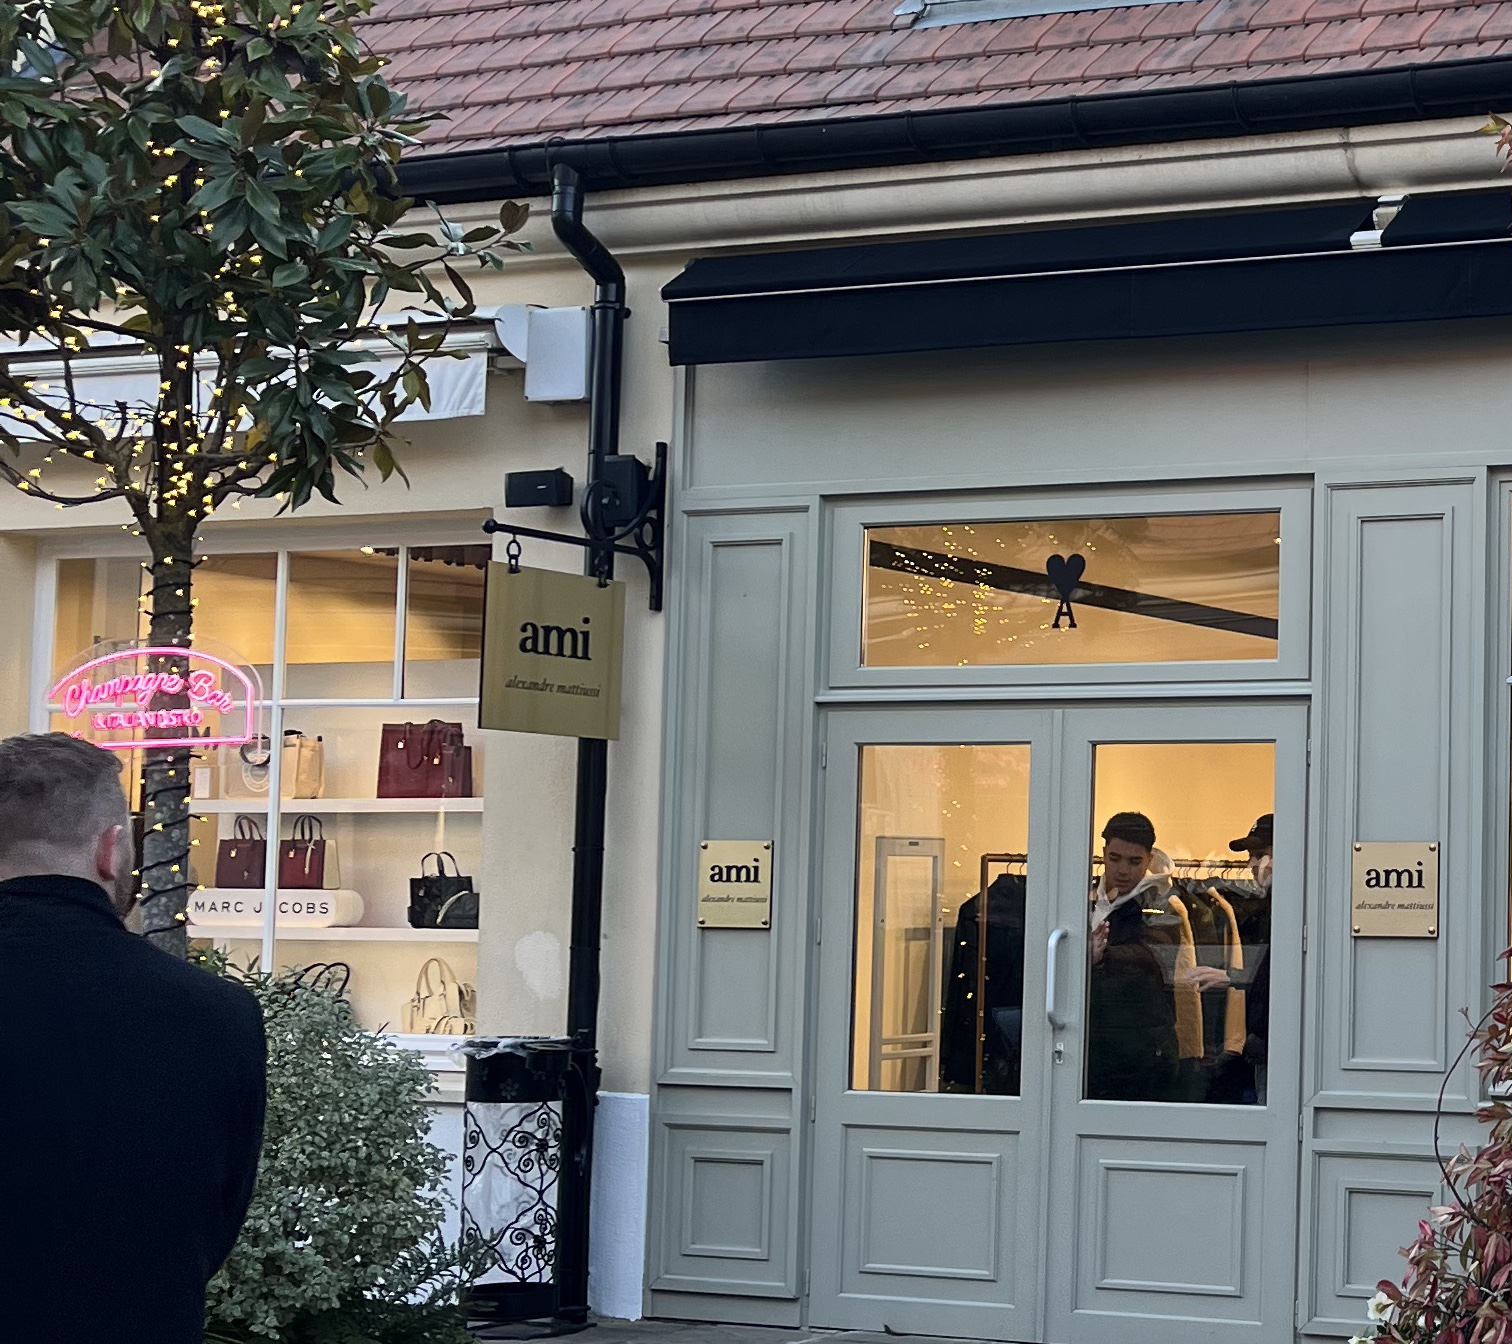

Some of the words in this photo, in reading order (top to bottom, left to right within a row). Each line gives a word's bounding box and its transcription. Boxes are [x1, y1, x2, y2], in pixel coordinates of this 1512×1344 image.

[519, 616, 592, 661] ami
[62, 672, 184, 717] Champagne
[188, 670, 234, 714] Bar
[505, 674, 555, 693] alexandre
[709, 858, 761, 884] ami
[1365, 860, 1425, 889] ami
[194, 901, 244, 913] MARC
[253, 901, 329, 915] JCOBS
